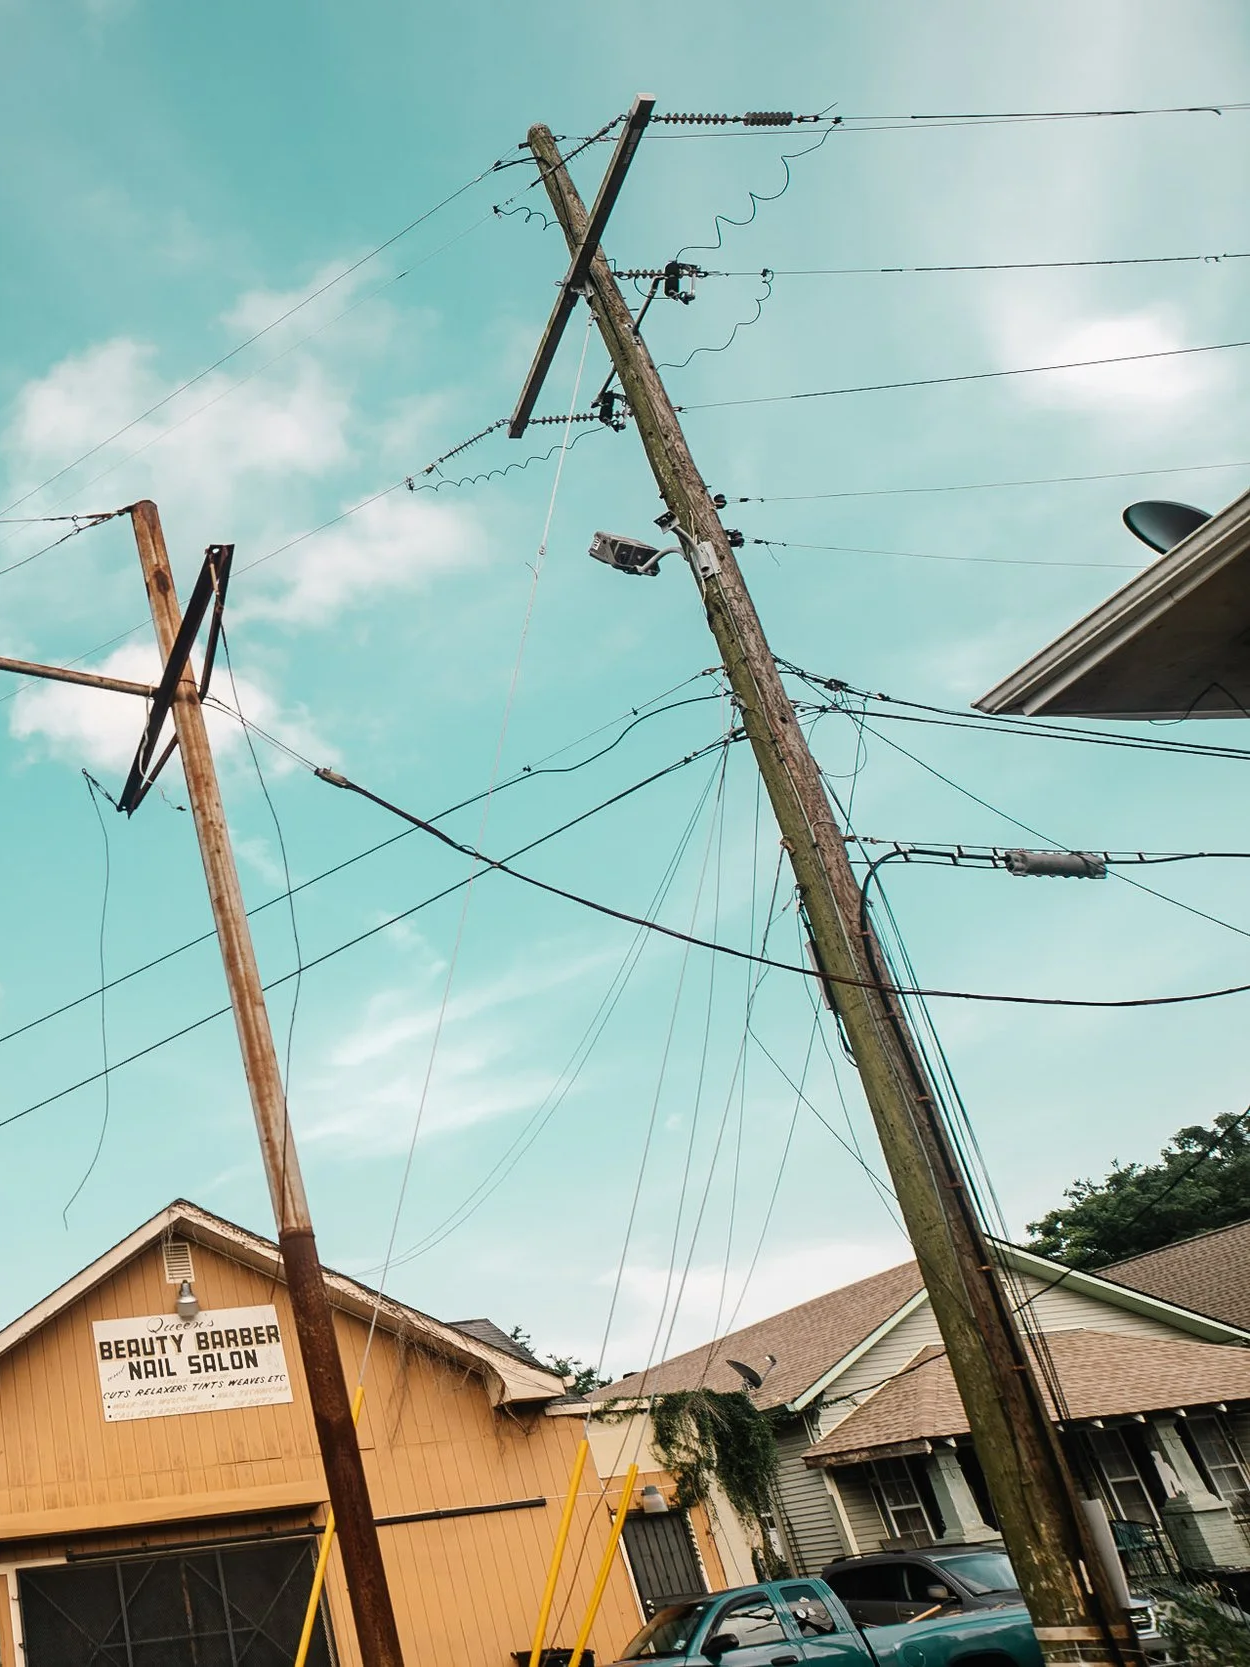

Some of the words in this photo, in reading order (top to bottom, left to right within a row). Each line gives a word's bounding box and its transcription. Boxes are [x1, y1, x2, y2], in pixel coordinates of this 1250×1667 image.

[147, 1313, 214, 1333] Queen's
[99, 1334, 184, 1360] BEAUTY
[196, 1325, 281, 1350] BARBER
[128, 1358, 177, 1380] NAIL
[187, 1349, 259, 1374] SALON
[102, 1390, 131, 1400] CUTS
[135, 1384, 188, 1397] RELAXERS
[192, 1381, 225, 1391] TINTS
[227, 1376, 266, 1387] WEAVES
[267, 1375, 286, 1383] ETC
